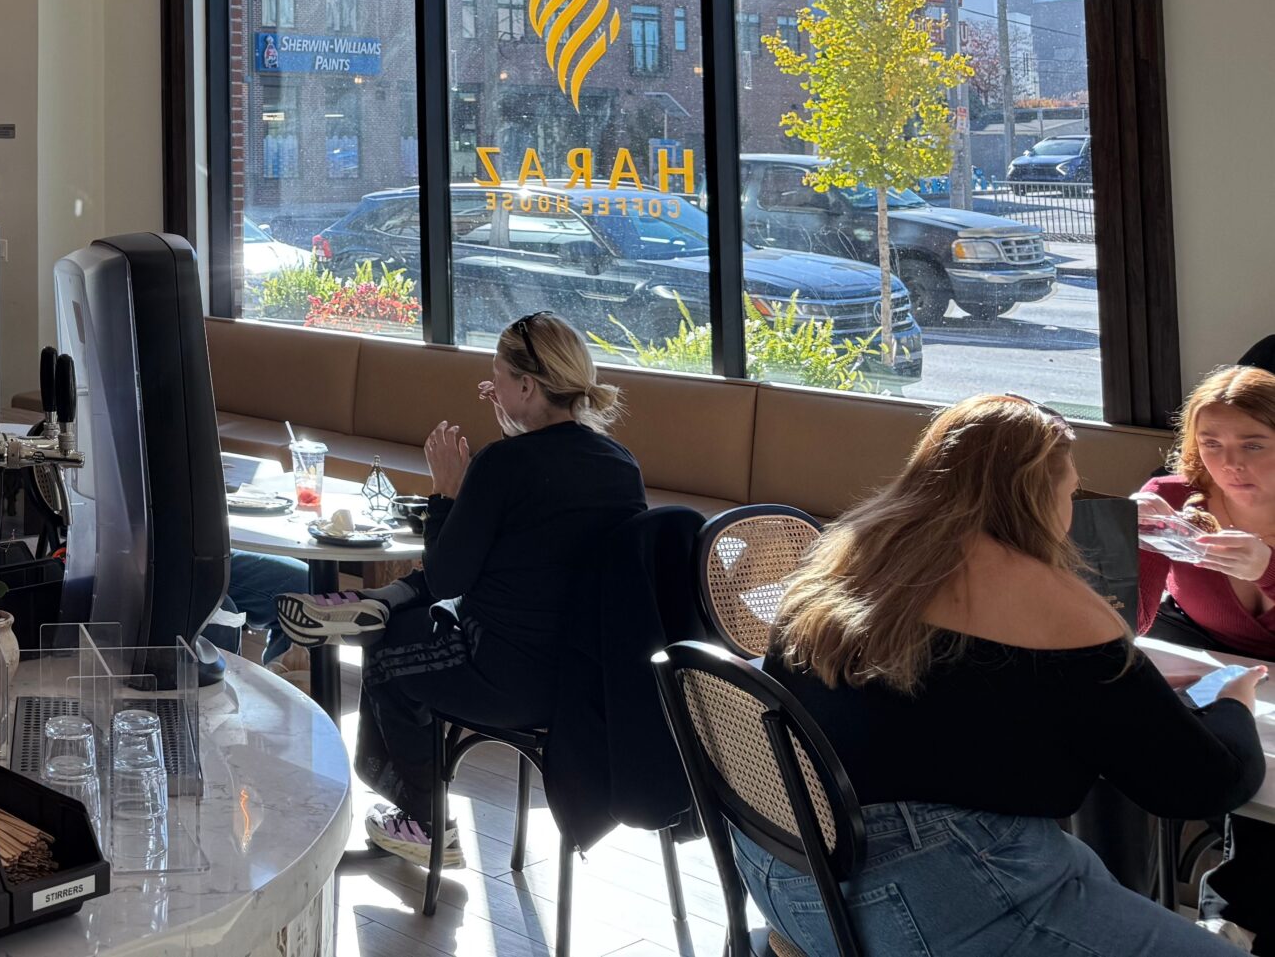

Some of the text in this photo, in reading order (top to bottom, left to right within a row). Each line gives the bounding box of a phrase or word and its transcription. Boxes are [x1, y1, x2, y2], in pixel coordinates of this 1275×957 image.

[280, 36, 381, 55] SHERWIN-WILLIAMS
[315, 55, 350, 71] PAINTS
[45, 884, 84, 903] STIRRERS
